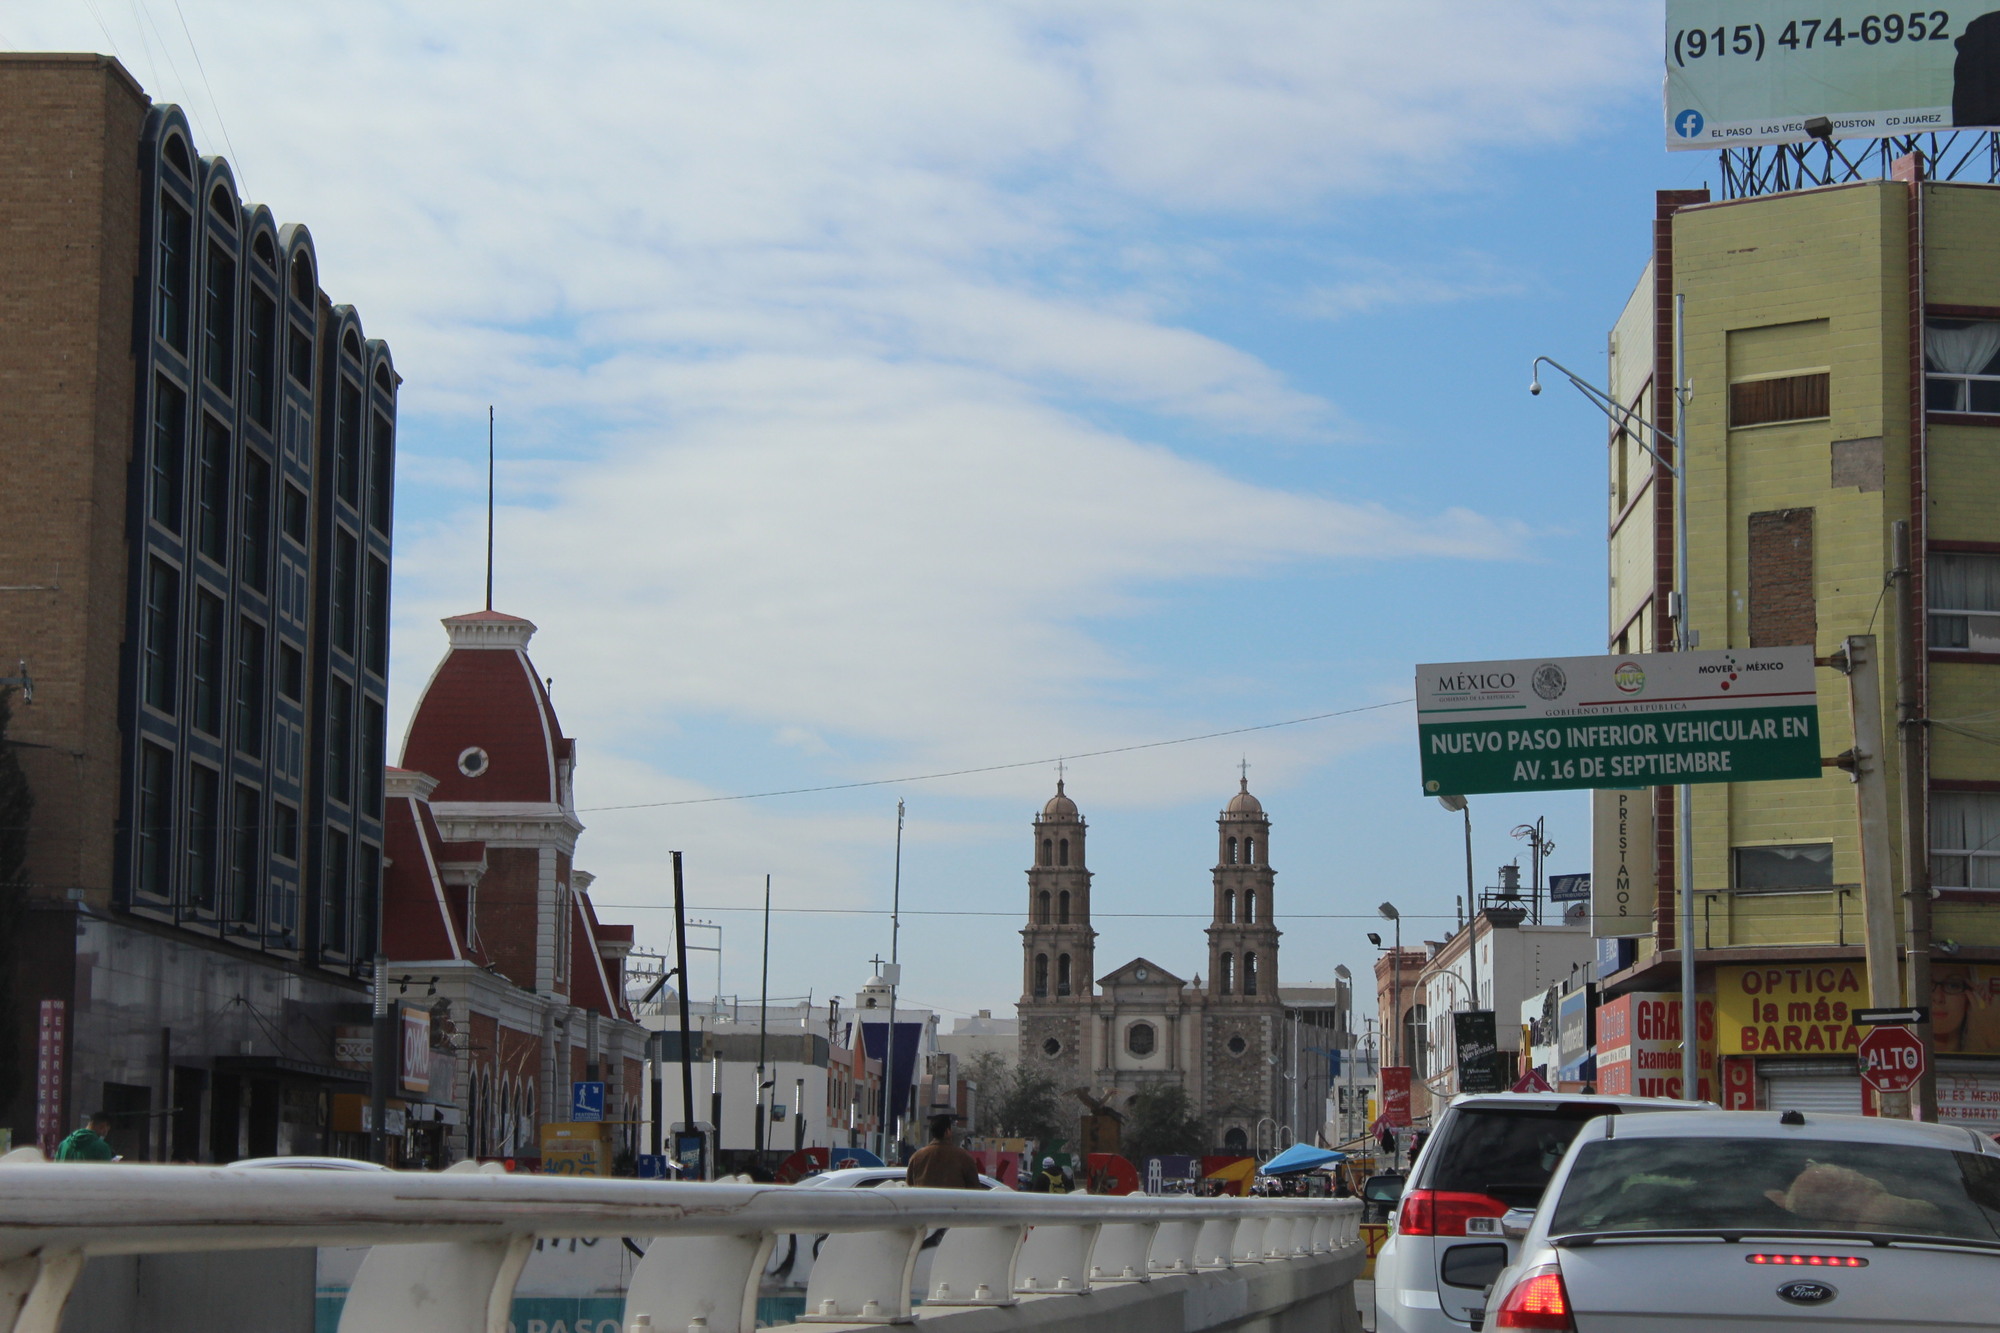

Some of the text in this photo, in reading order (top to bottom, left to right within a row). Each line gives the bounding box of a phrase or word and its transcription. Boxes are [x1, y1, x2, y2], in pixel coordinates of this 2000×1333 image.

[1674, 10, 1950, 67] (915) 474-6952
[1761, 123, 1806, 134] LAS VEG
[1886, 114, 1941, 126] CD JUAREZ
[1712, 127, 1753, 138] EL PASO
[1699, 661, 1784, 674] MOVER MÉXICO
[1439, 672, 1516, 692] MÉXICO
[1545, 707, 1599, 717] GOBIERNO
[1602, 706, 1615, 714] DE
[1618, 705, 1630, 713] LA
[1431, 716, 1809, 754] NUEVO PASO INFERIOR VEHICULAR EN
[1513, 751, 1732, 782] AV. 16 DE SEPTIEMBRE
[1572, 877, 1591, 893] te
[1741, 967, 1860, 995] OPTICA
[1752, 996, 1849, 1023] la más
[1741, 1024, 1863, 1051] BARATA
[338, 1043, 374, 1058] OXXO
[405, 1026, 431, 1078] OXXO
[1637, 1048, 1682, 1070] Examén
[1868, 1046, 1918, 1071] ALTO
[1638, 1077, 1711, 1101] VISA
[1791, 1284, 1823, 1299] Ford
